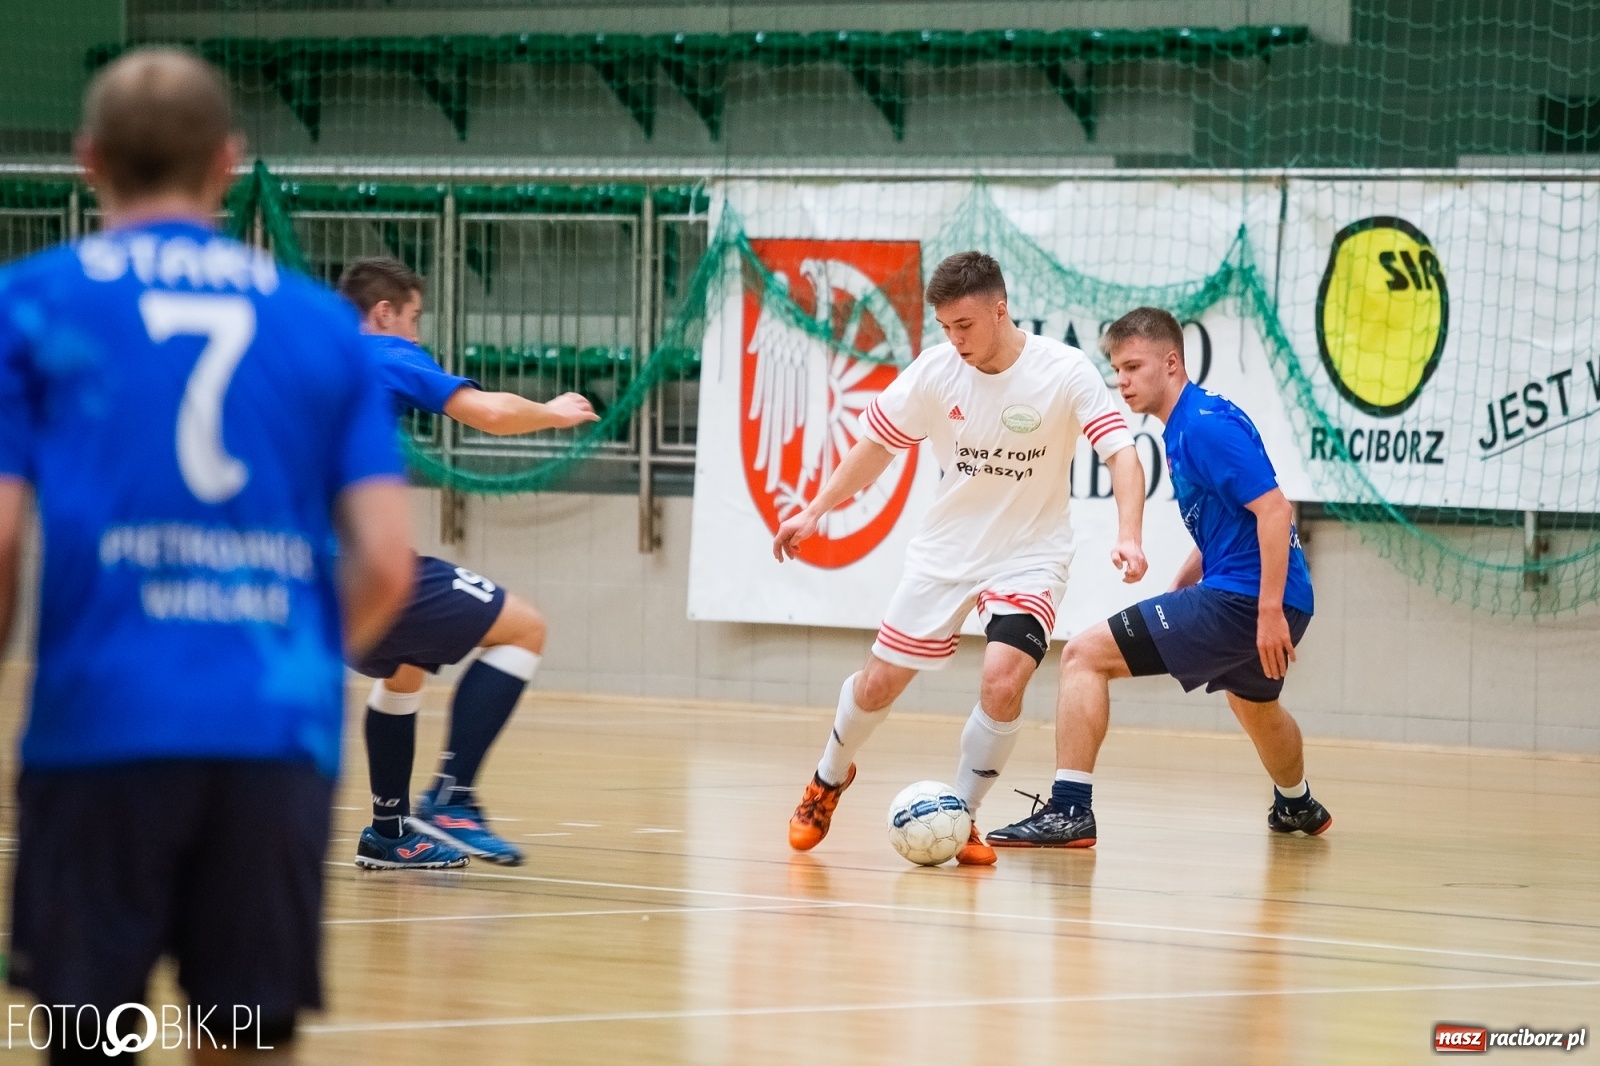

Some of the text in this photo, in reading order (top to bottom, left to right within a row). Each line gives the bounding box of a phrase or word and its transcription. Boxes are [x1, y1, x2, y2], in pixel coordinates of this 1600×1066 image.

[139, 289, 257, 503] 7
[1478, 368, 1573, 450] JEST
[1007, 445, 1047, 462] rolki
[452, 566, 497, 604] 19
